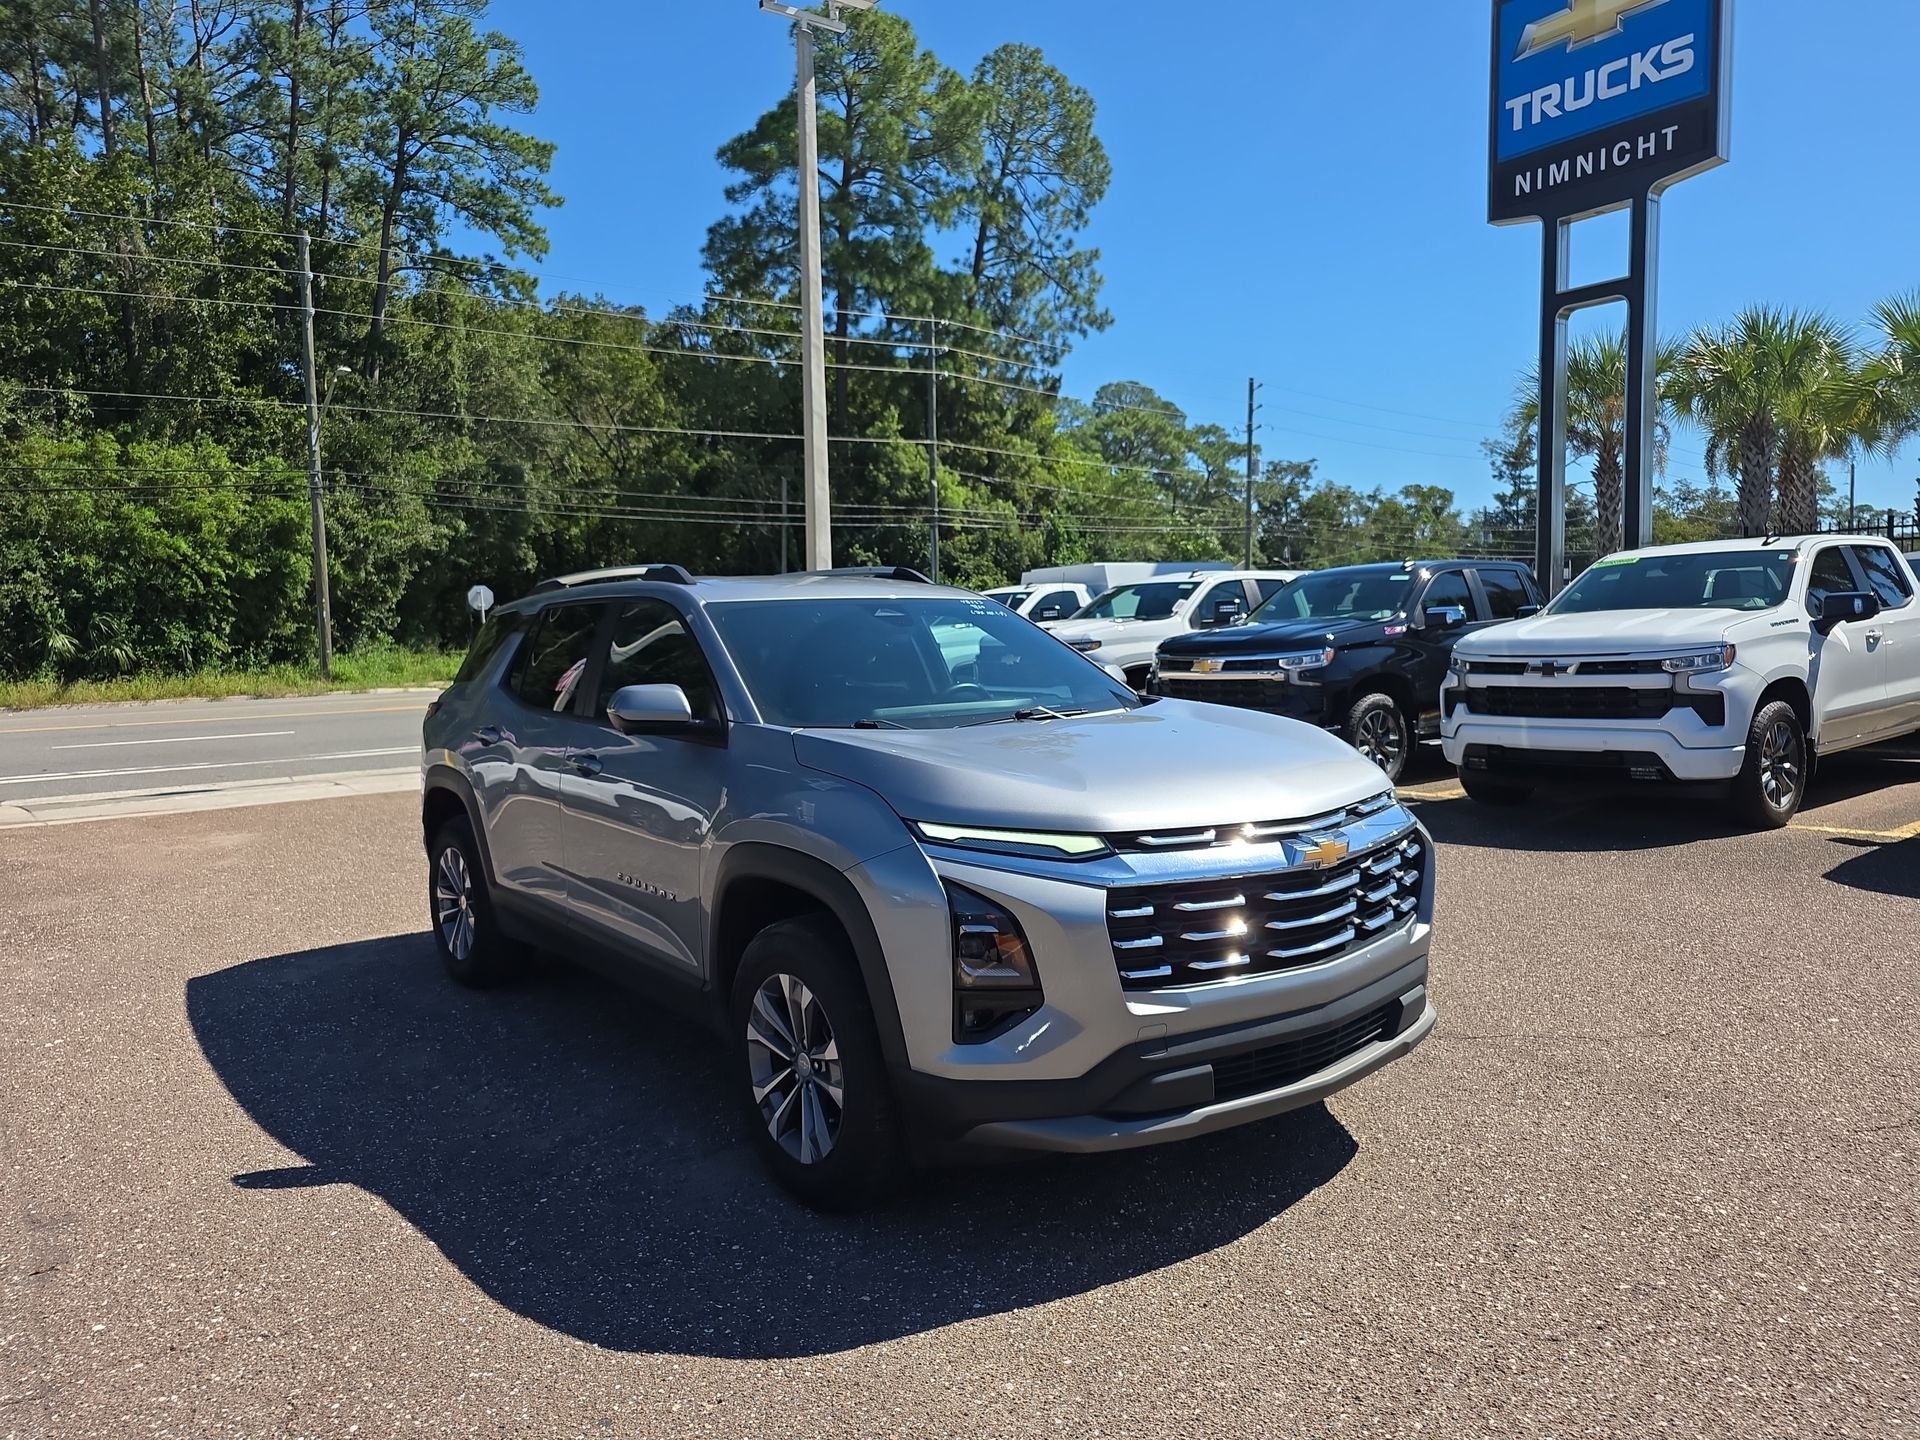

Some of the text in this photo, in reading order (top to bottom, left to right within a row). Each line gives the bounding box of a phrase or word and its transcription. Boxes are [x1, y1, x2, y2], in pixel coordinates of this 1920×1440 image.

[1505, 33, 1694, 131] TRUCKS
[1514, 125, 1679, 196] NIMNICHT
[617, 872, 677, 902] EQUINOX
